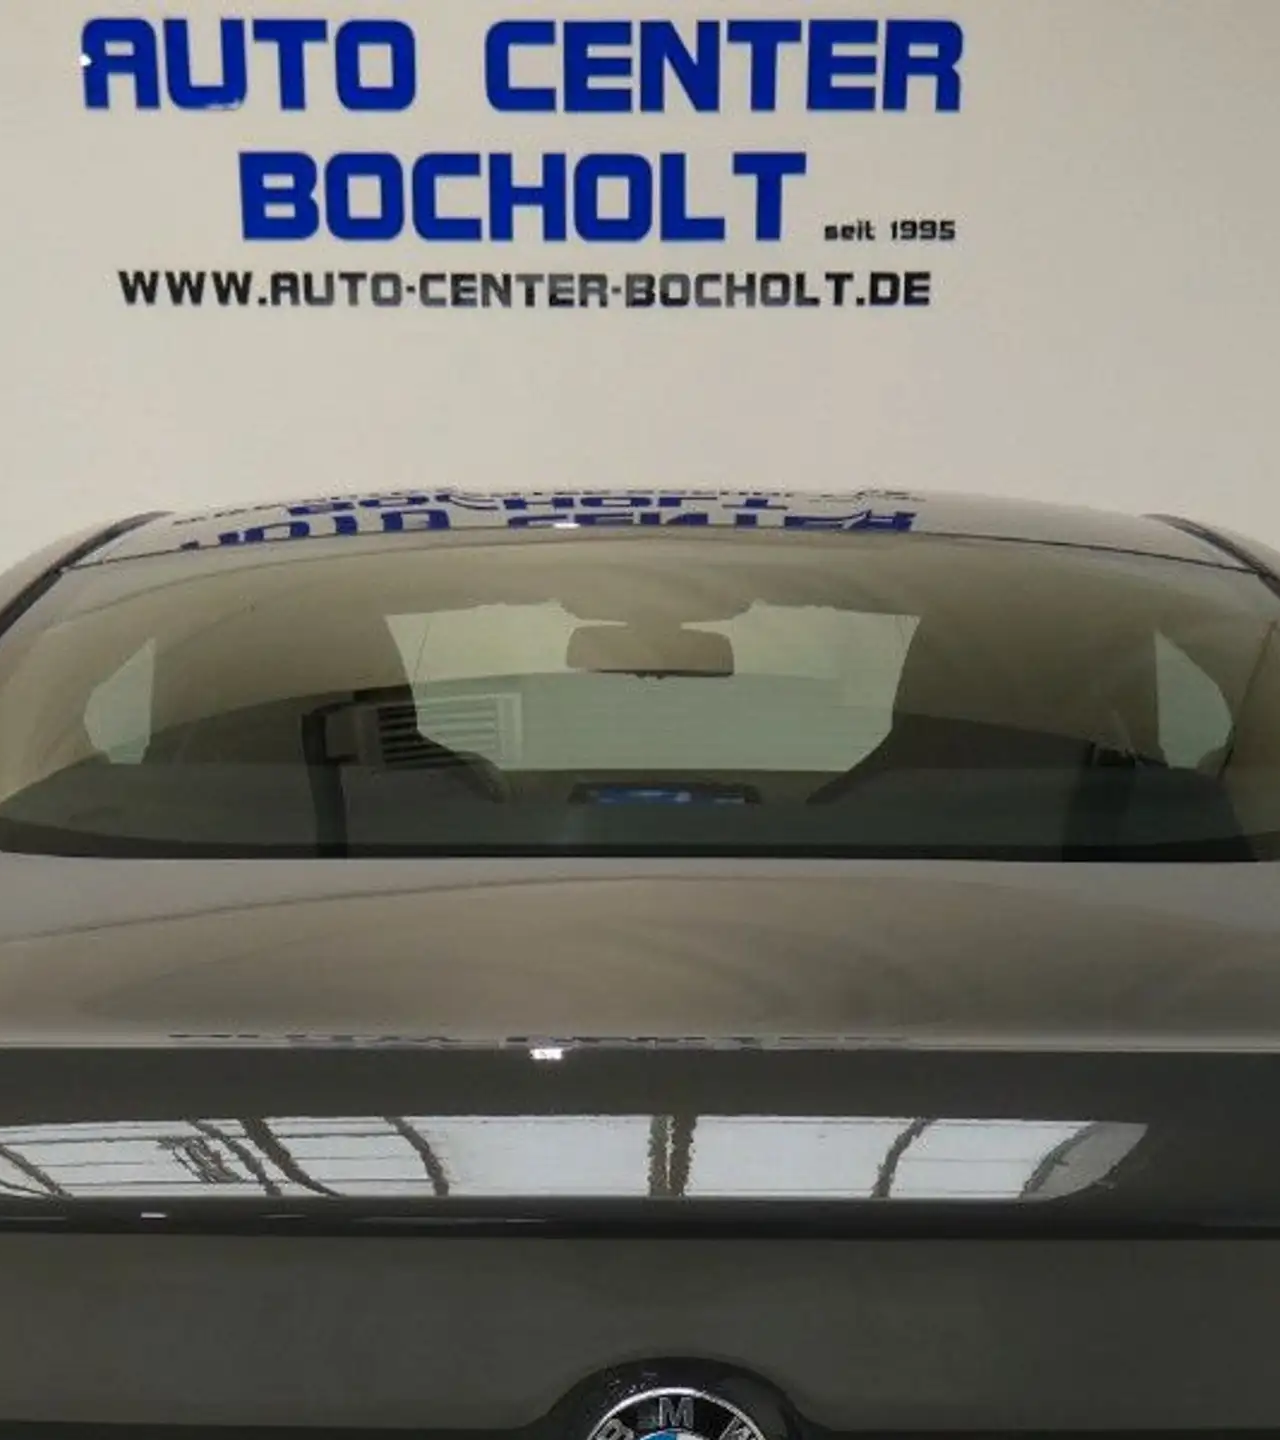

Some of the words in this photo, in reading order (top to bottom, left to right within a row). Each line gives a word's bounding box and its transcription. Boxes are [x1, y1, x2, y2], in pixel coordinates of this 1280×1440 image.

[81, 18, 418, 113] AUTO
[485, 20, 965, 115] CENTER
[239, 152, 808, 243] BOCHOLT
[823, 220, 877, 243] seit
[889, 219, 957, 243] 1995
[117, 270, 933, 310] WWW.AUTO-CENTER-BOCHOLT.DE
